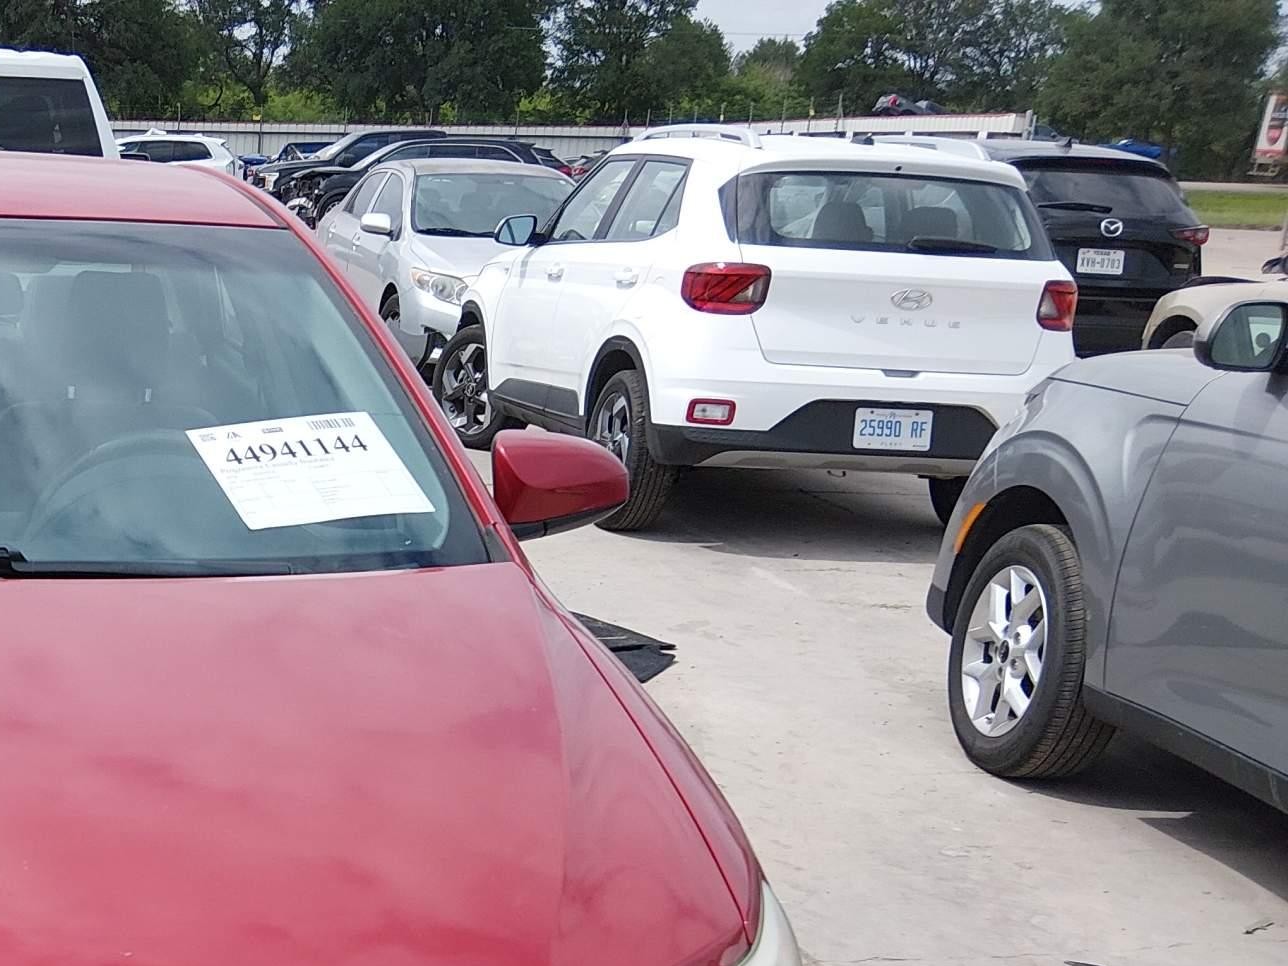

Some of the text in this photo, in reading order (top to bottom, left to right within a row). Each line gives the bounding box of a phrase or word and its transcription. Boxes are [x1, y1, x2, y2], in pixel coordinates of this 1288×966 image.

[859, 419, 928, 438] 25990 RF
[225, 434, 369, 464] 44941144
